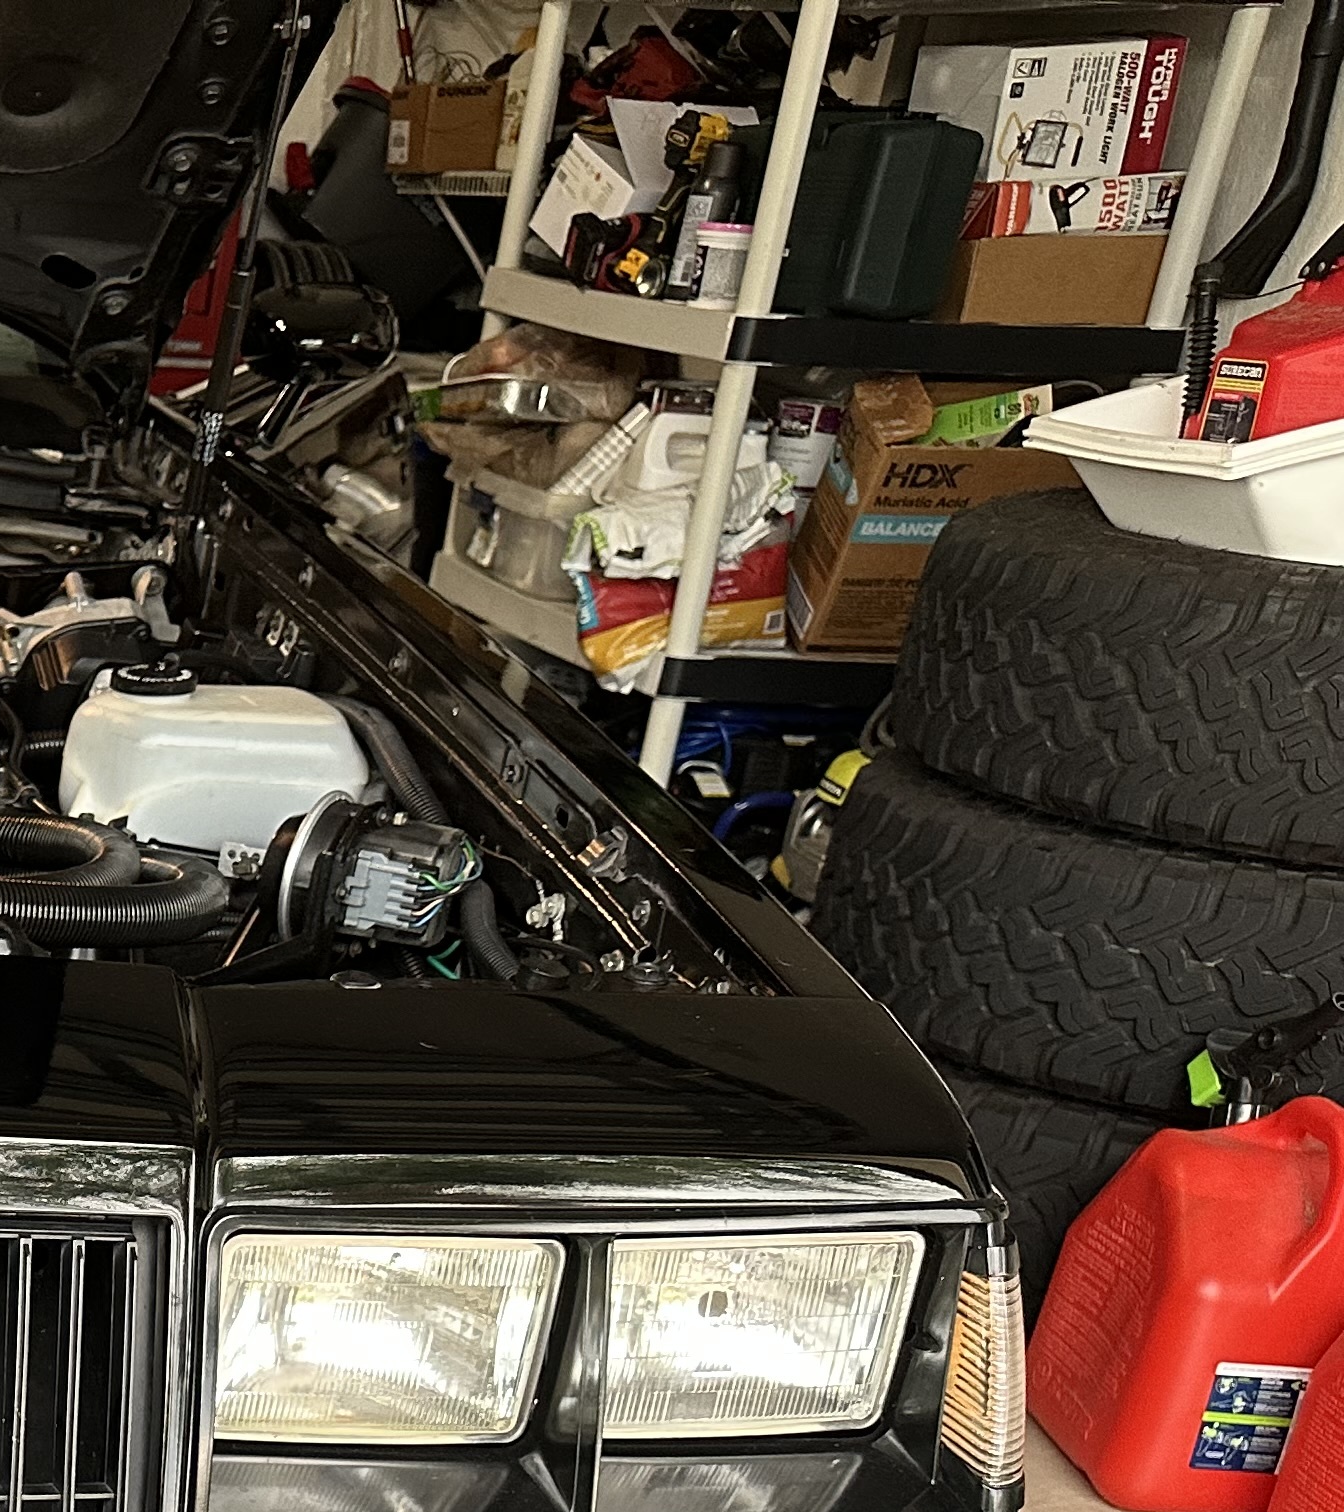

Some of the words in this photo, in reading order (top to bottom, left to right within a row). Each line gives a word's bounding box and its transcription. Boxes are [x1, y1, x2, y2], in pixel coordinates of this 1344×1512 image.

[1113, 52, 1130, 99] HALOGEN
[1119, 51, 1141, 115] 500-WATT
[1139, 49, 1170, 140] TOUGH
[1160, 48, 1178, 101] HYPER
[1106, 102, 1119, 133] WORK
[1098, 135, 1112, 164] LIGHT
[1094, 178, 1116, 233] 1500
[1108, 178, 1130, 233] WATT
[882, 462, 974, 489] HDX
[936, 497, 970, 508] Acid
